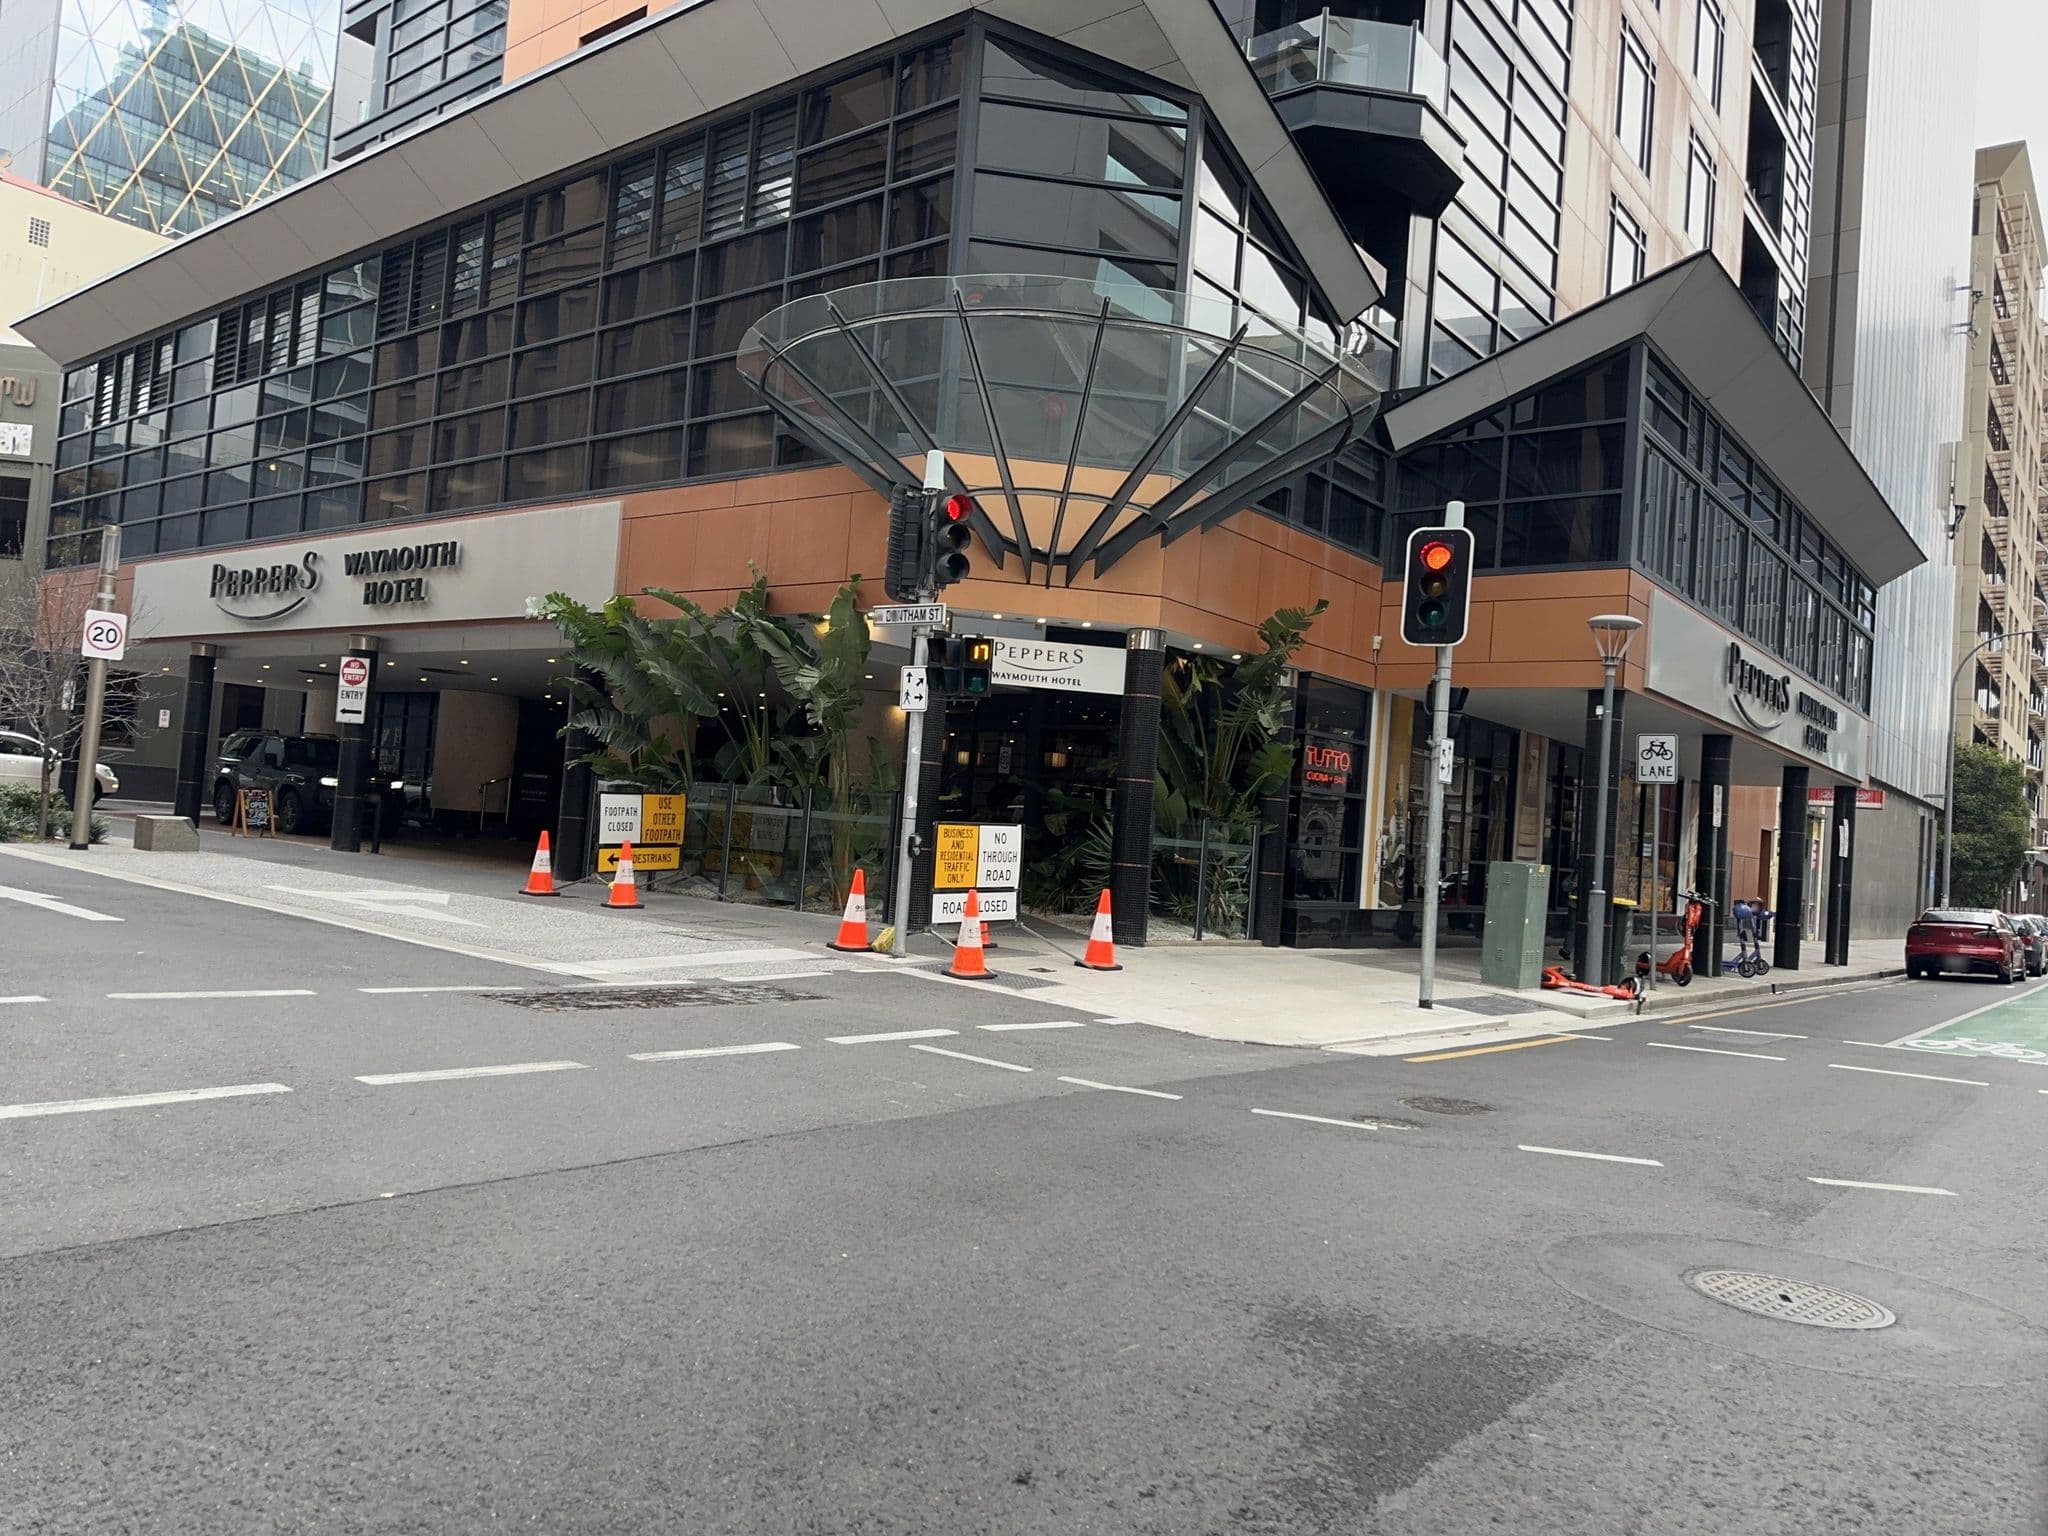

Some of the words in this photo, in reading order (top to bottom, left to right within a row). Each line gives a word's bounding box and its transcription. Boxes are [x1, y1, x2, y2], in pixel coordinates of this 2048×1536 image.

[344, 541, 459, 577] WAYMOUTH
[210, 551, 319, 599] PEPPERS
[363, 577, 426, 606] HOTEL
[928, 608, 940, 621] ST
[93, 626, 118, 644] 20
[994, 641, 1084, 665] PEPPERS
[343, 673, 364, 681] ENTRY
[992, 671, 1048, 683] WAYMOUTH
[1051, 676, 1082, 687] HOTEL
[1728, 642, 1791, 713] PEPPERS
[340, 690, 364, 700] ENTRY
[1305, 745, 1351, 772] TUTTO
[1640, 765, 1673, 777] LANE
[658, 797, 672, 809] USE
[604, 806, 638, 817] FOOTPATH
[653, 813, 676, 825] OTHER
[607, 822, 634, 832] CLOSED
[644, 829, 681, 841] FOOTPATH
[943, 828, 974, 839] BUSINESS
[994, 832, 1007, 845] NO
[950, 840, 965, 850] AND
[632, 853, 672, 864] DESTRIANS
[940, 851, 974, 861] RESIDENTIAL
[983, 851, 1018, 863] THROUGH
[943, 862, 970, 872] TRAFFIC
[946, 874, 964, 884] ONLY
[985, 869, 1012, 882] ROAD
[978, 900, 1008, 913] LOSED
